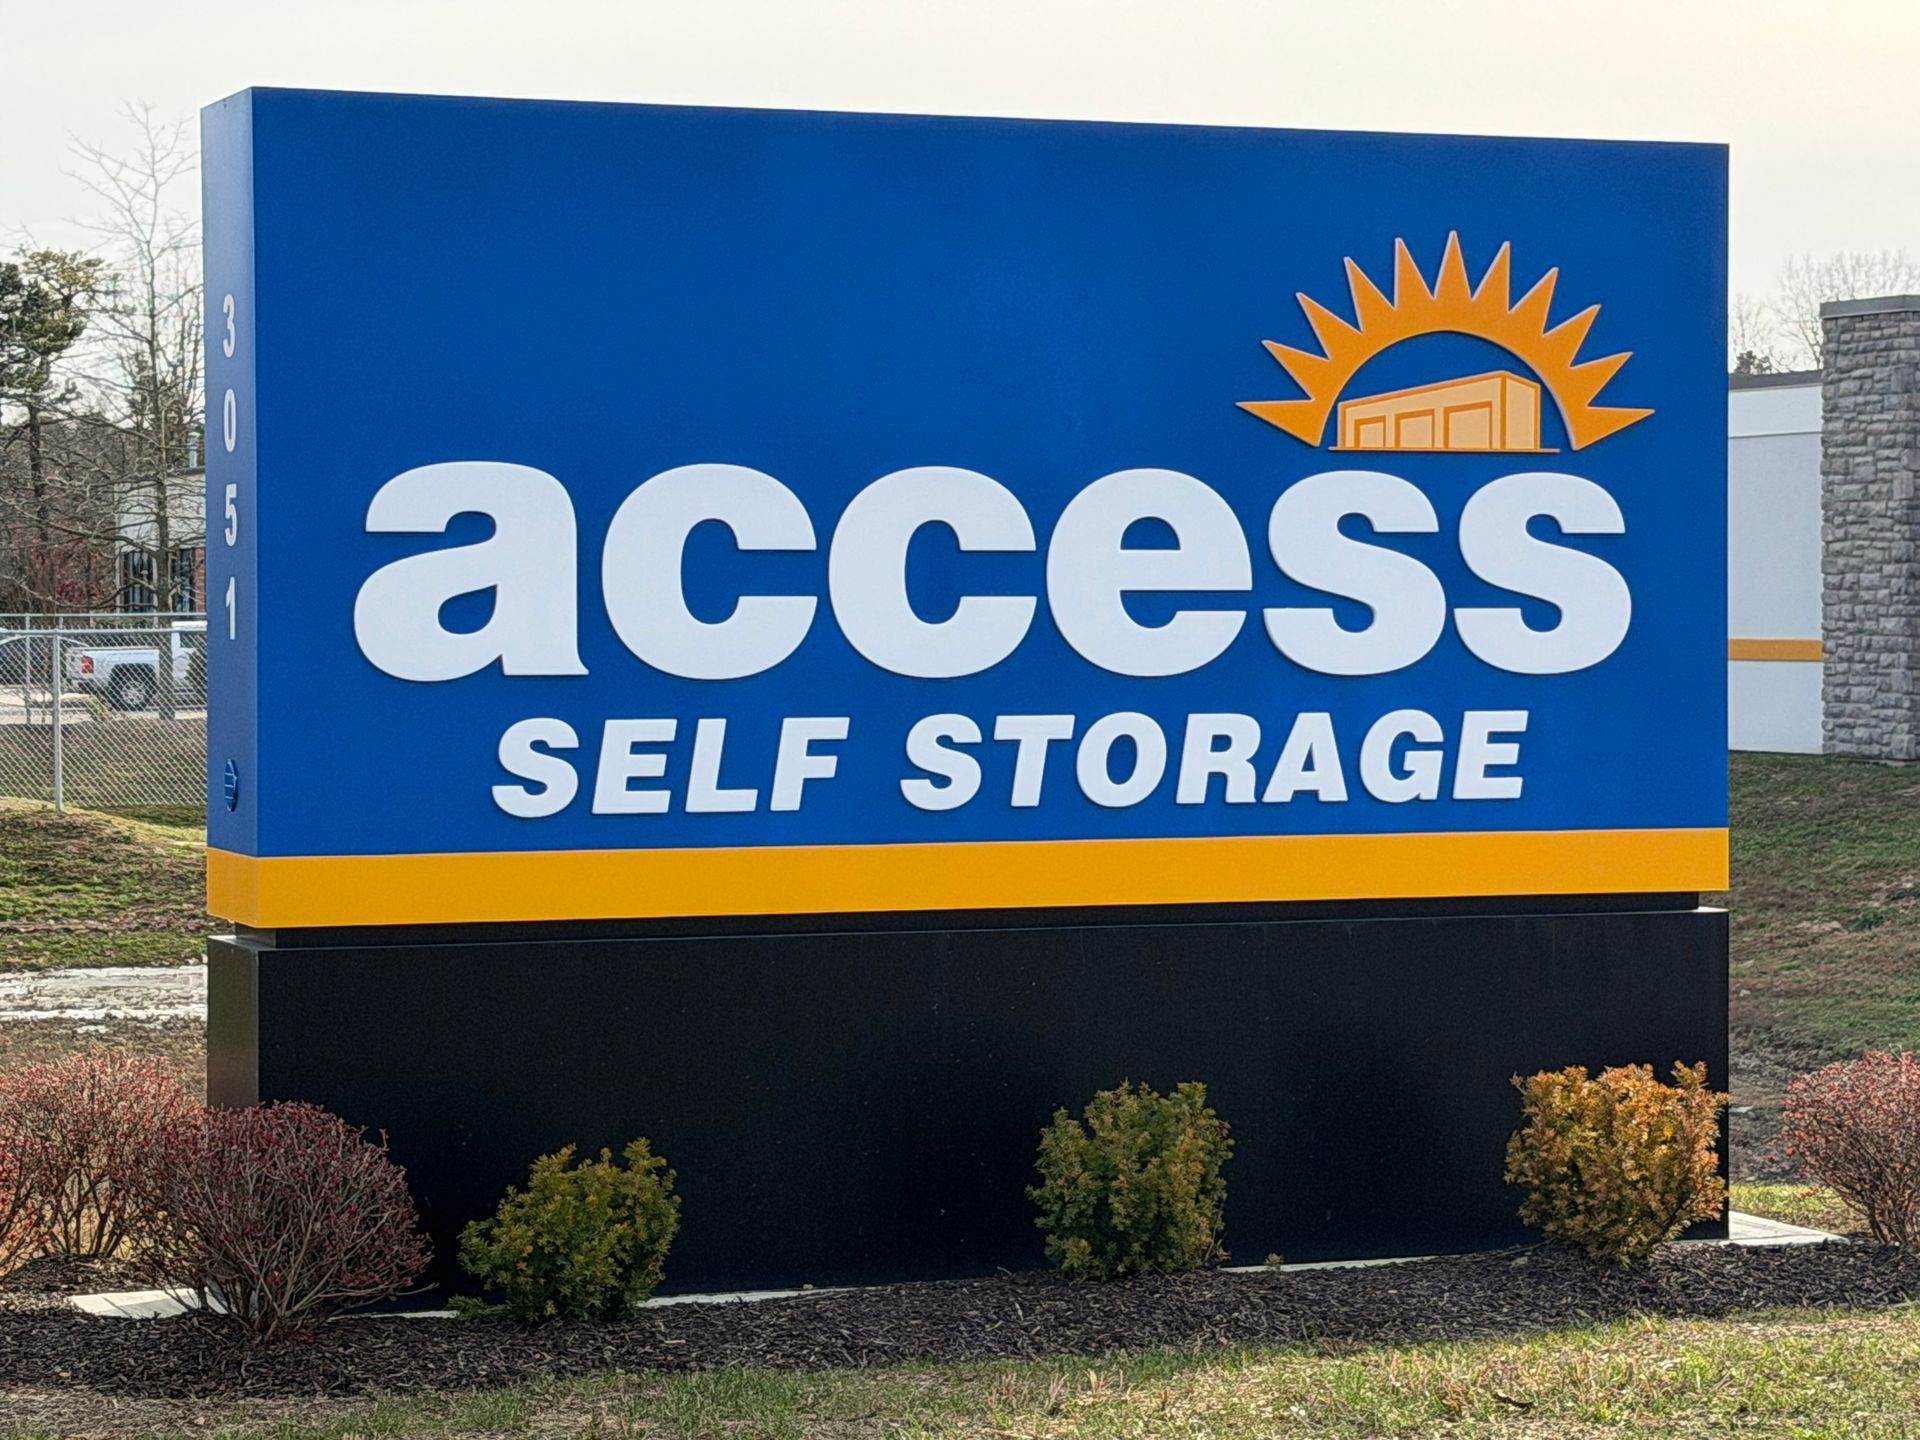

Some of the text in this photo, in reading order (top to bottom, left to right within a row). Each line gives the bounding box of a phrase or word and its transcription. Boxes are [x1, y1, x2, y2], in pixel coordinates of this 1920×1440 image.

[222, 293, 238, 640] 3051
[353, 461, 1632, 681] access
[491, 709, 1529, 818] SELF STORAGE
